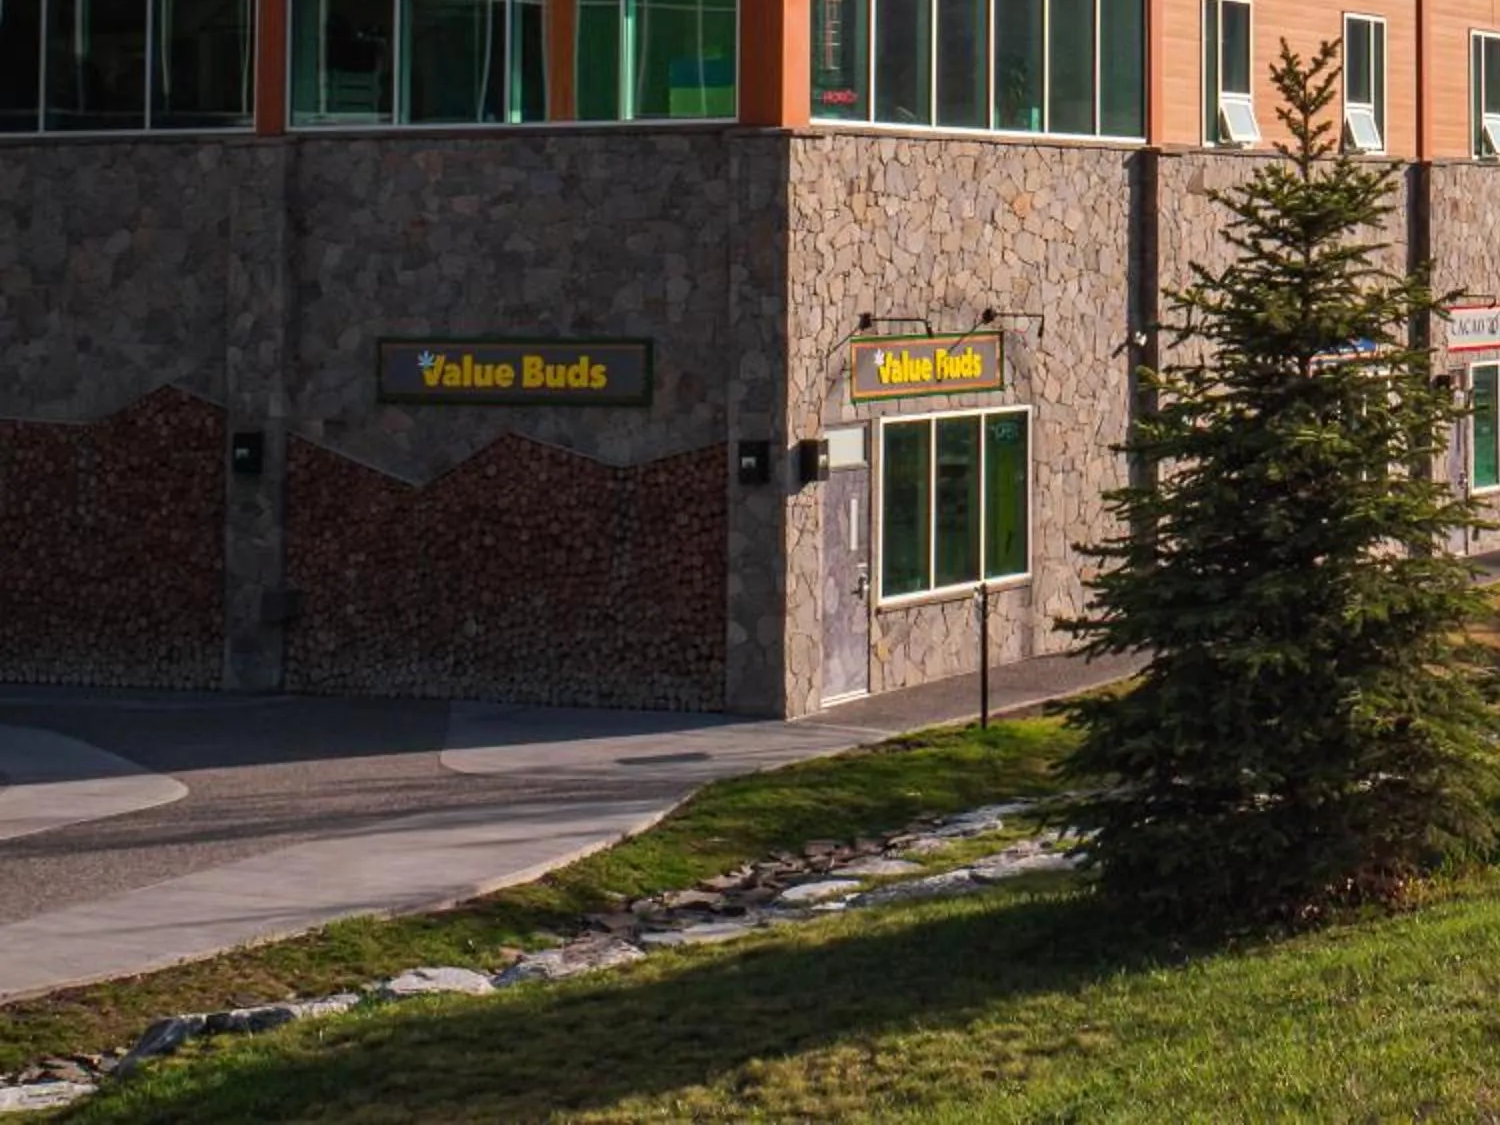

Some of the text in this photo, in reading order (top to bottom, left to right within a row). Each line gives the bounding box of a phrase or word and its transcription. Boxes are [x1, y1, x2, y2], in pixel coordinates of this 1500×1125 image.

[423, 354, 608, 389] Value Buds
[879, 346, 982, 384] Value Buds
